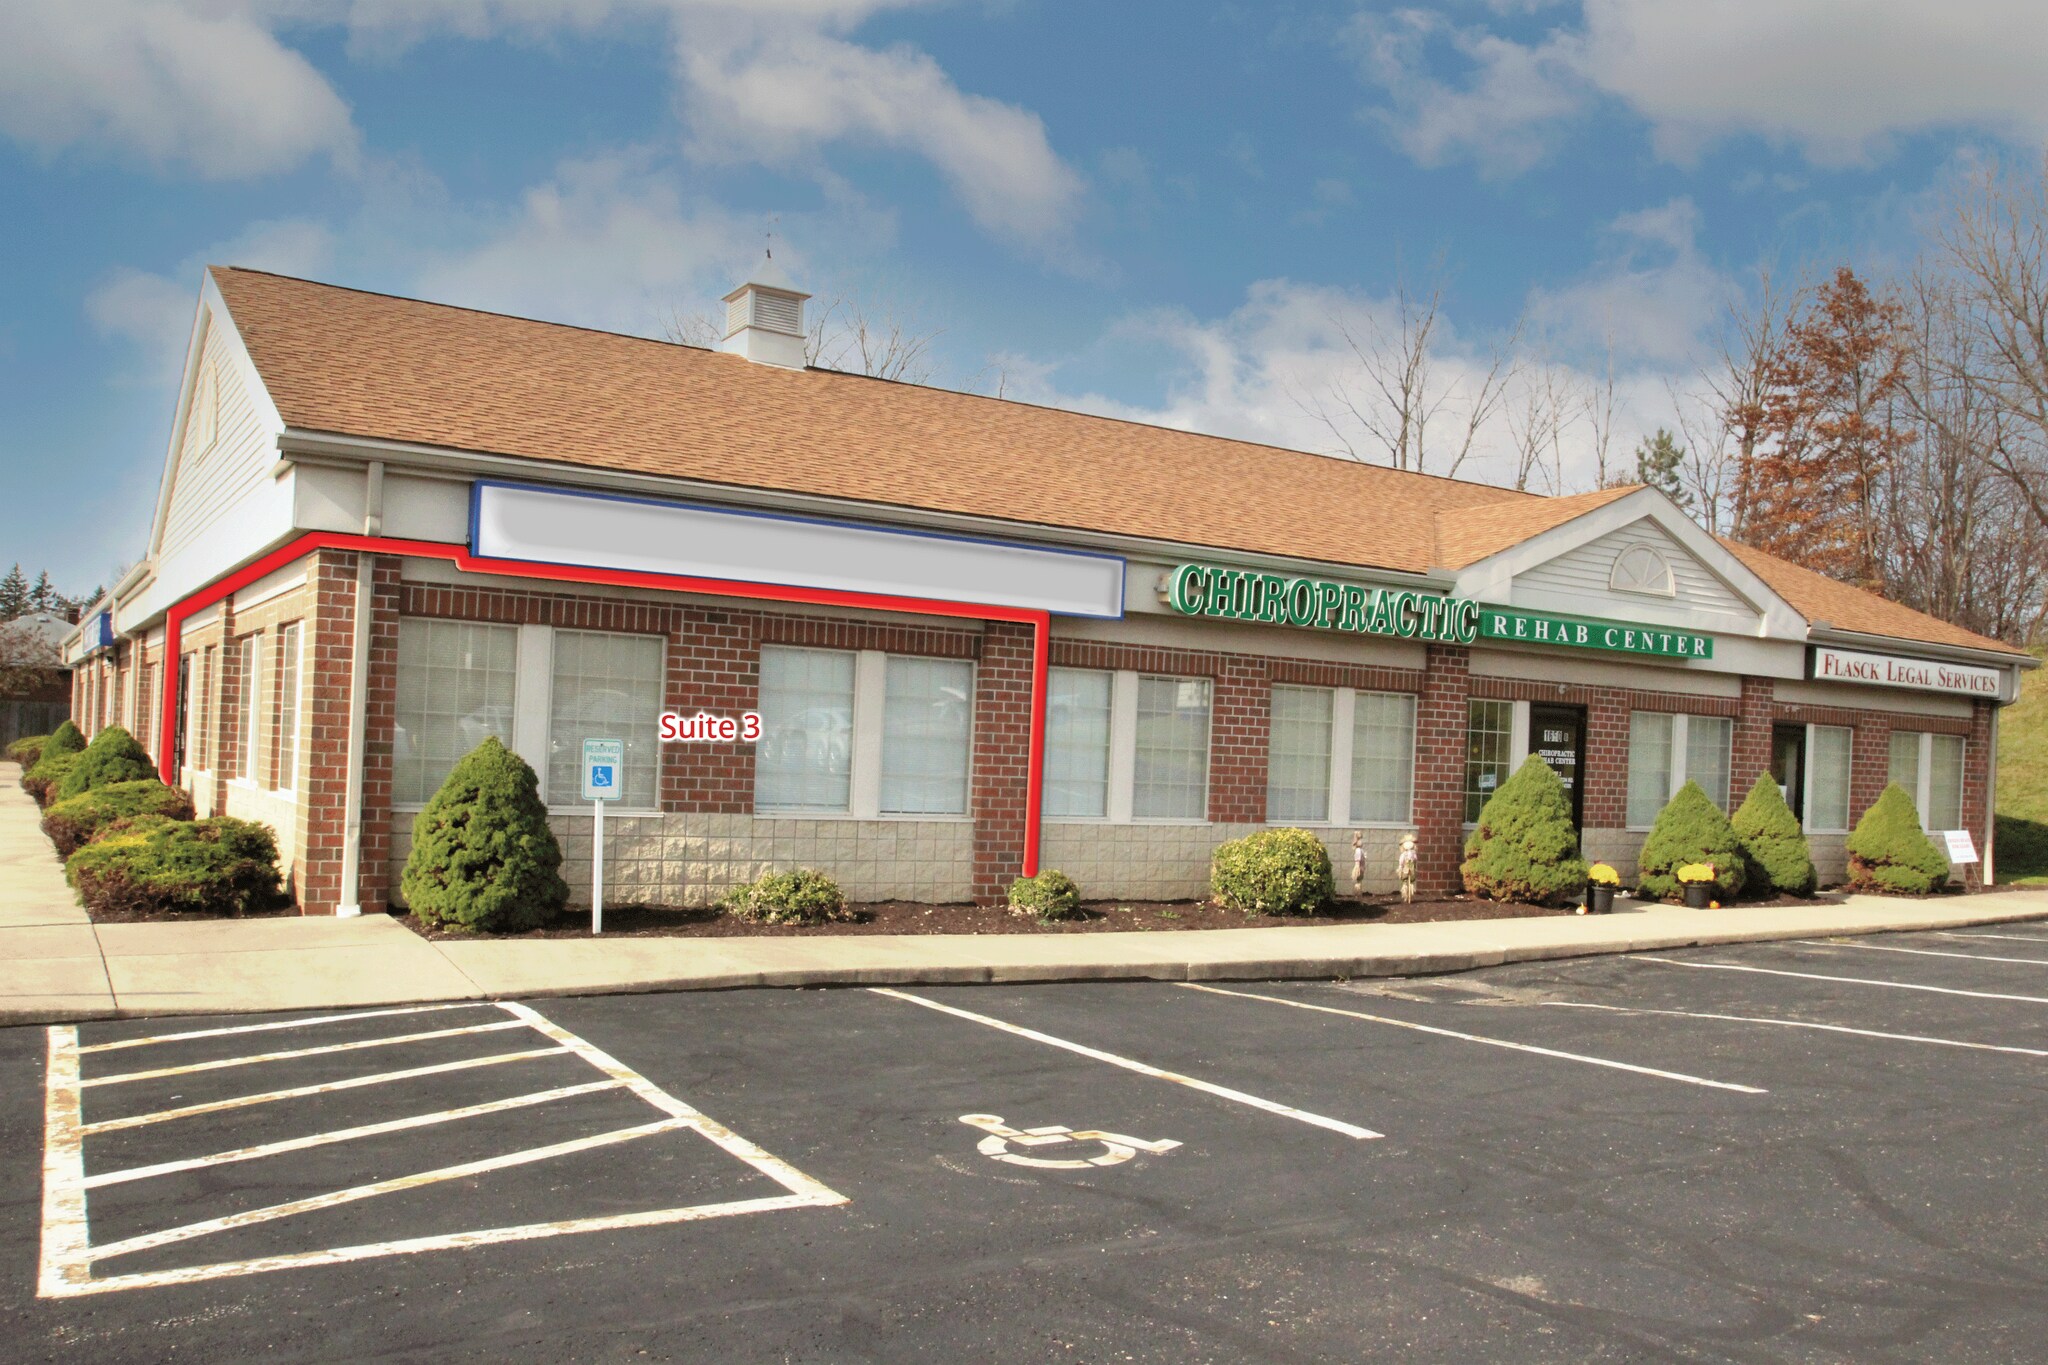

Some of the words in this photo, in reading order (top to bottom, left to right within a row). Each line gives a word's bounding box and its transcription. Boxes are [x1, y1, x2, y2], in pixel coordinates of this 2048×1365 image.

[1173, 564, 1479, 643] CHIROPRACTIC
[1493, 615, 1589, 643] REHAB
[1604, 628, 1706, 656] CENTER
[1823, 653, 1880, 681] FLASCK
[1887, 660, 1932, 686] LEGAL
[1937, 666, 1996, 693] SERVICES
[585, 745, 620, 754] RESERVED
[589, 755, 617, 763] PARKING
